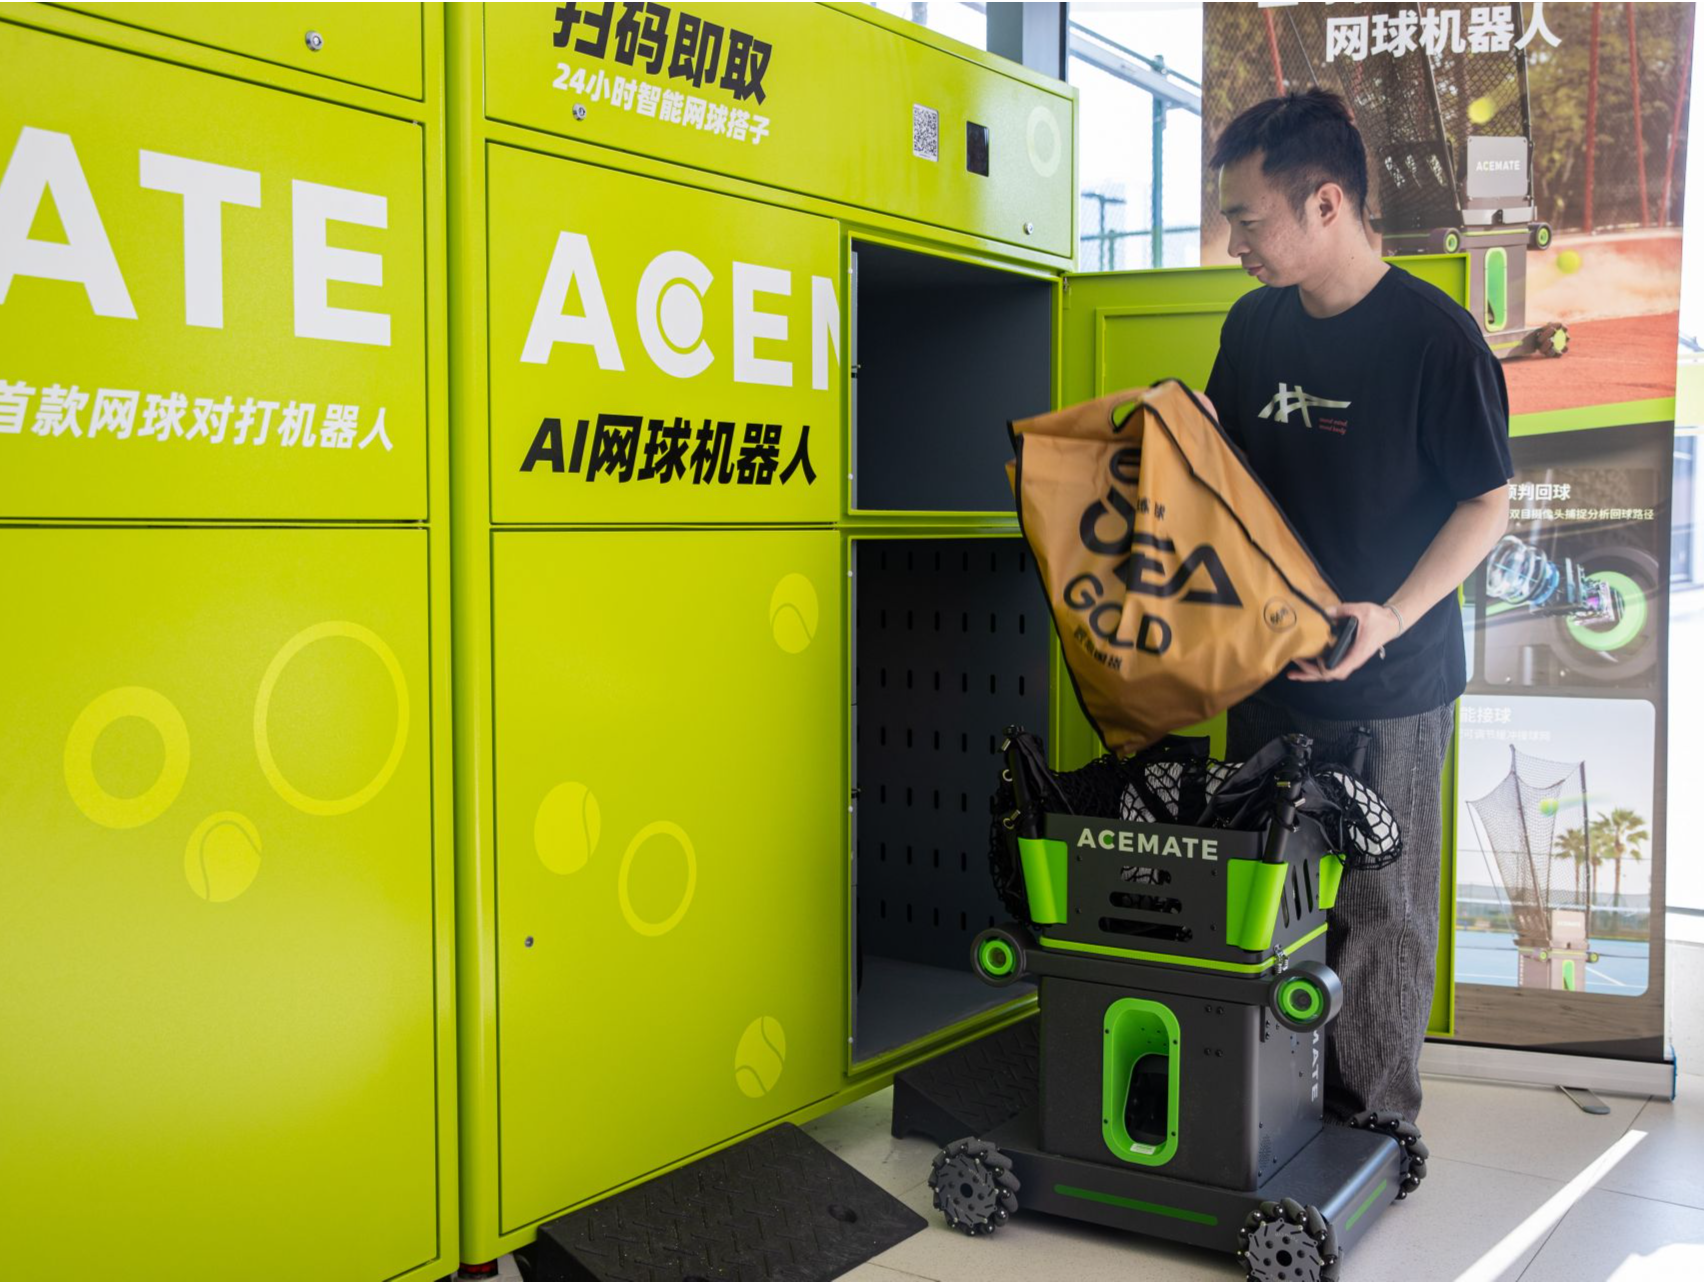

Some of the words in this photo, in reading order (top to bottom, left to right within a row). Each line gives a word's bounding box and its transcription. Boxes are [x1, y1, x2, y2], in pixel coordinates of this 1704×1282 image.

[553, 2, 772, 105] 扫码即取
[1326, 2, 1562, 62] 网球机器人
[552, 62, 770, 145] 24小时智能网球搭子
[1476, 160, 1521, 172] ACEMATE
[0, 380, 393, 452] 首款网球对打机器人
[519, 414, 817, 486] AI网球机器人
[1077, 828, 1218, 861] ACEMATE
